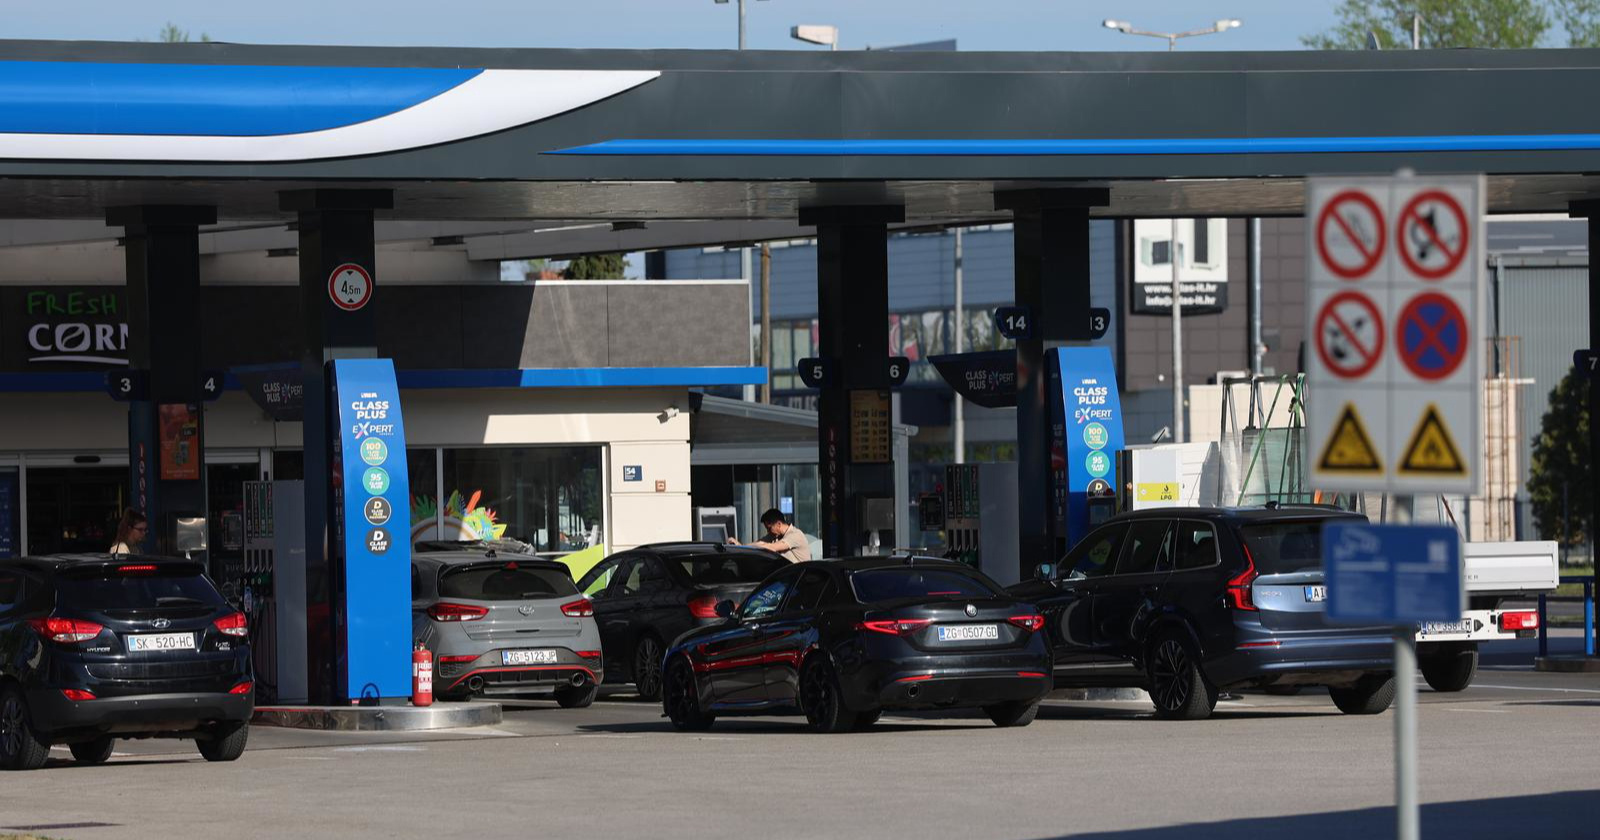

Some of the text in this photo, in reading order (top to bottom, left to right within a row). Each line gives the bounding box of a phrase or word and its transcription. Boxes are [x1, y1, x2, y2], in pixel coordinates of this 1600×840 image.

[27, 291, 117, 315] FRESH
[1006, 315, 1026, 331] 14
[1588, 356, 1599, 371] 7
[813, 365, 823, 380] 5
[889, 364, 900, 379] 6
[965, 369, 987, 381] CLASS
[120, 377, 131, 393] 3
[204, 377, 216, 392] 4
[263, 382, 281, 393] CLASS
[969, 380, 986, 391] PLUS
[1074, 387, 1108, 396] CLASS
[266, 392, 281, 403] PLUS
[1078, 396, 1106, 405] PLUS
[351, 401, 389, 410] CLASS
[356, 410, 387, 420] PLUS
[1087, 427, 1102, 435] 100
[366, 442, 382, 451] 100
[1092, 456, 1103, 464] 95
[626, 467, 636, 475] 54
[370, 473, 382, 481] 95
[1095, 482, 1103, 491] D
[373, 501, 382, 509] D
[373, 530, 384, 541] D
[946, 628, 958, 639] ZG
[136, 638, 149, 650] SK
[509, 652, 520, 662] ZG
